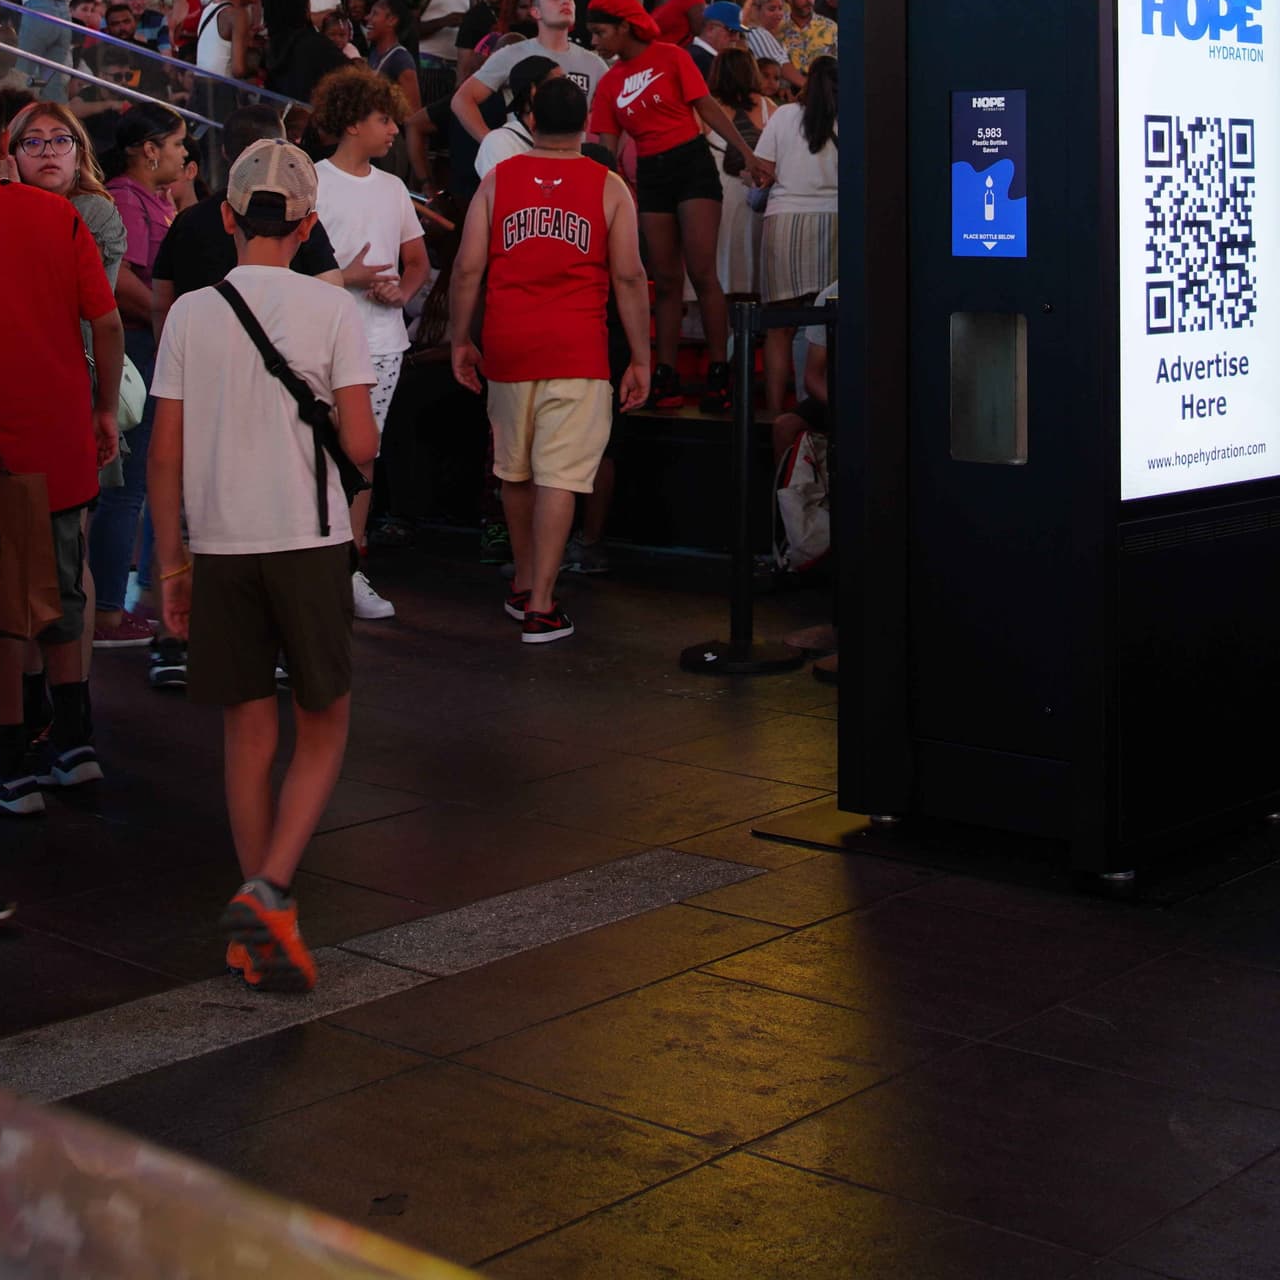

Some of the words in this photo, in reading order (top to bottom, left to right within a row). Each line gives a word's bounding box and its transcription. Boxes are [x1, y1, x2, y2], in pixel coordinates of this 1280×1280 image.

[1209, 45, 1264, 63] HYDRATION
[623, 67, 654, 96] NIKE
[626, 94, 663, 117] AIR
[972, 97, 1006, 108] HOPE
[977, 128, 1002, 139] 5,983
[503, 207, 592, 254] CHICAGO
[1156, 351, 1249, 384] Advertise
[1181, 394, 1227, 420] Here
[1148, 442, 1267, 470] www.hopehydration.com
